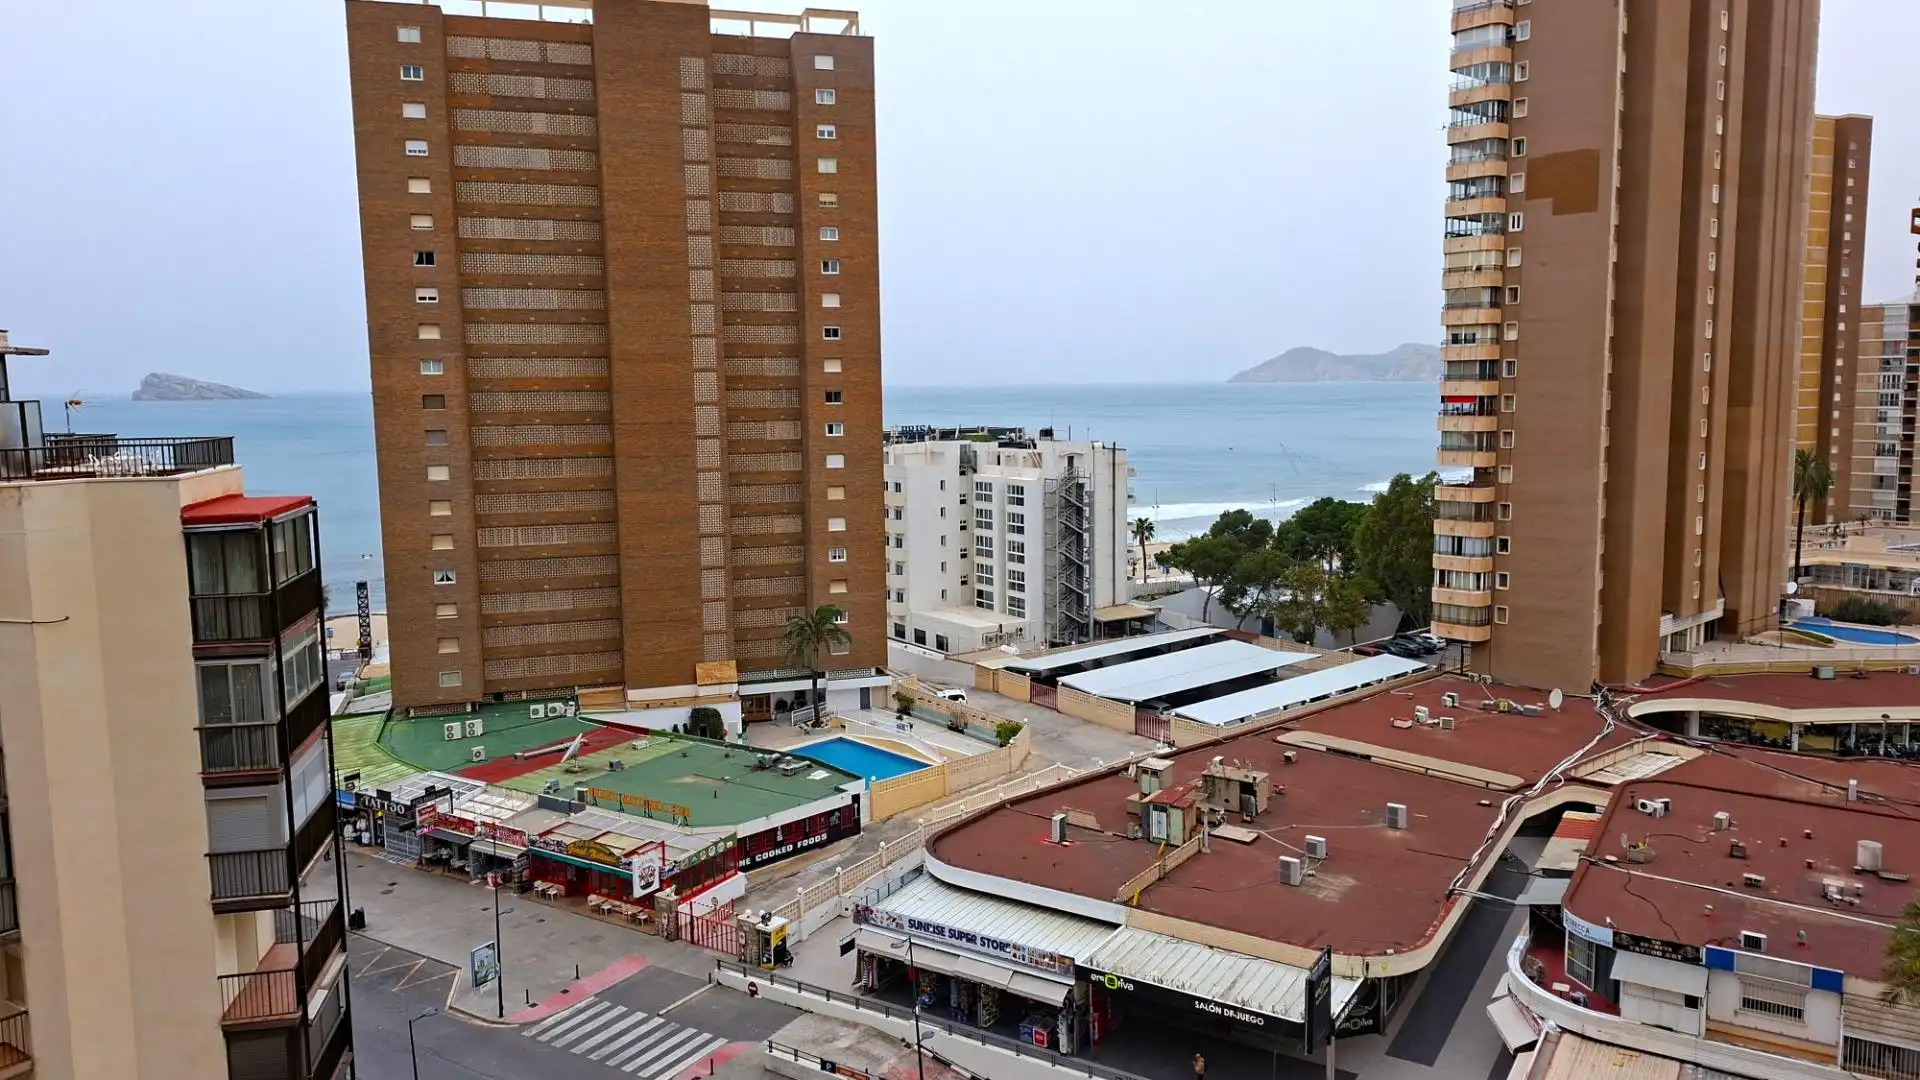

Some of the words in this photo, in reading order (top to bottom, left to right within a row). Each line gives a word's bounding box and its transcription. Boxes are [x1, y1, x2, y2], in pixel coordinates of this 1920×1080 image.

[363, 796, 405, 814] TATTOO
[755, 844, 794, 862] COOKED
[797, 833, 828, 849] FOODS
[948, 928, 978, 945] SUPER
[1195, 1001, 1222, 1014] SALÓN
[1235, 1012, 1264, 1025] JUEGO
